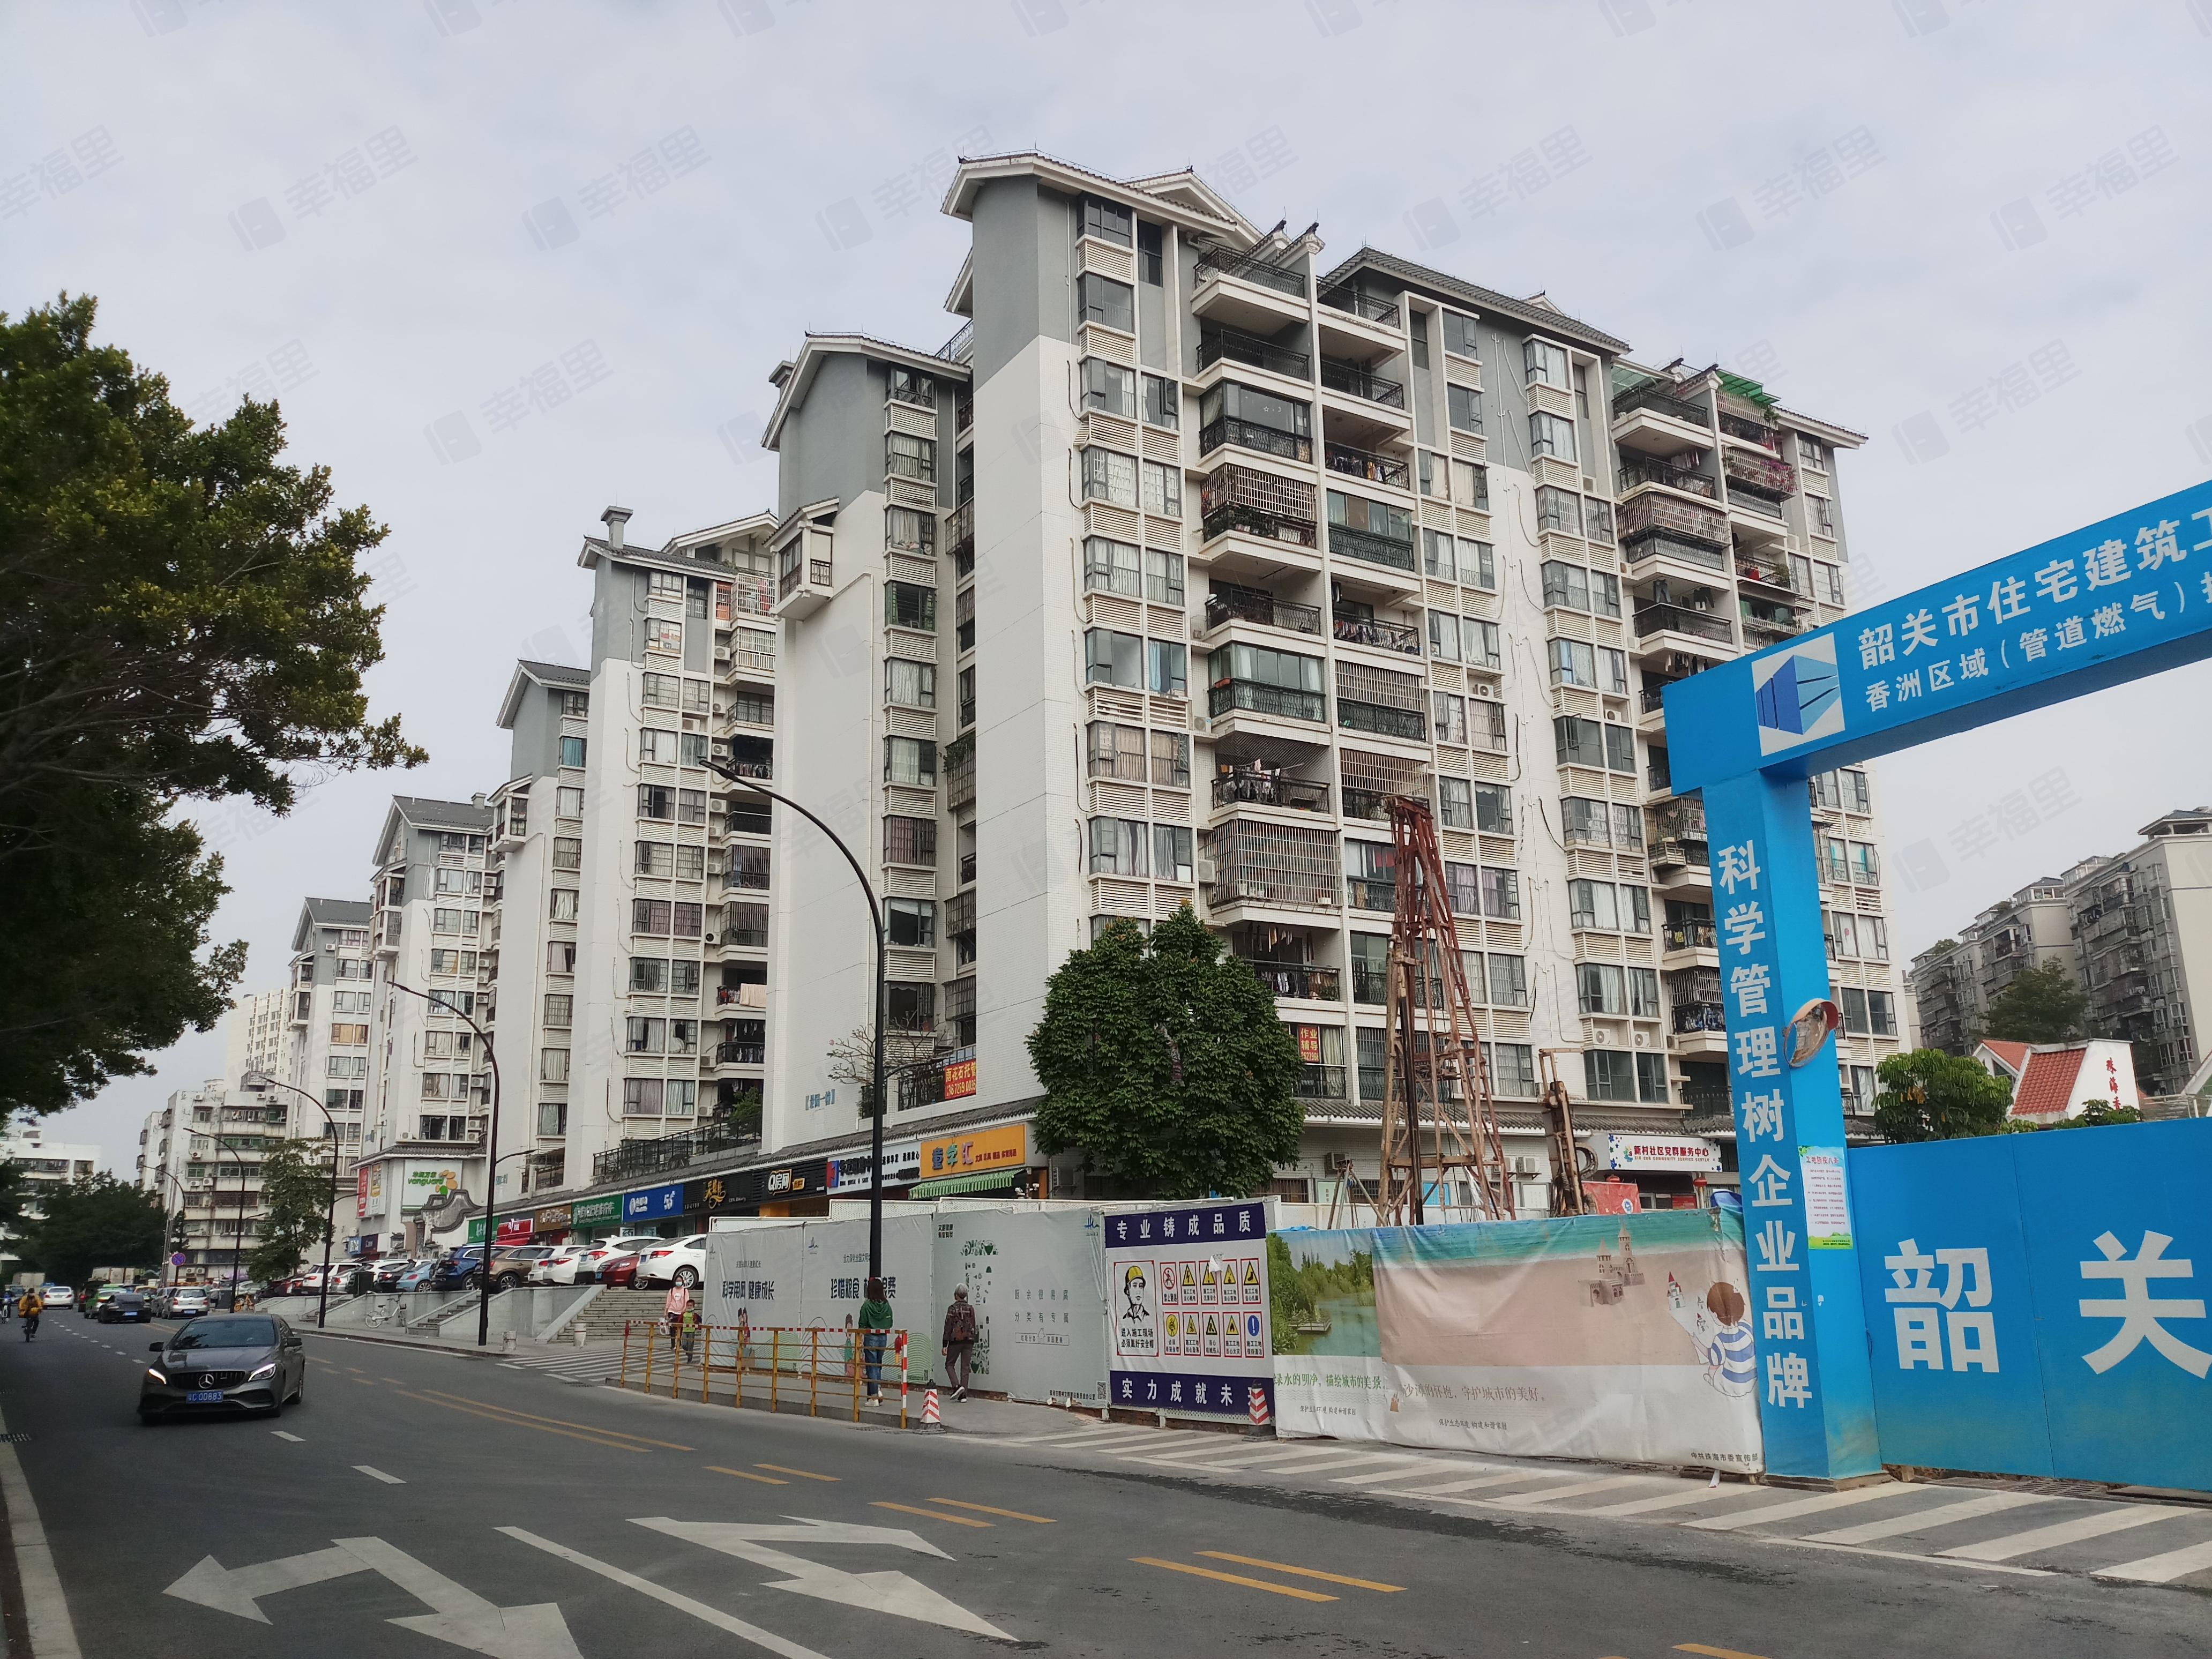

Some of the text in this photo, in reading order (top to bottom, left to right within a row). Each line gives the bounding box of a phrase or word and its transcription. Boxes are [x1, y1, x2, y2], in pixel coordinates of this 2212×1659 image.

[1301, 1028, 1318, 1038] 作业
[1301, 1040, 1318, 1051] 辅导
[946, 1062, 976, 1082] 雨花石托管
[1717, 840, 1813, 1409] 科学管理树企业品牌
[932, 1141, 974, 1171] 童学汇
[1634, 1145, 1709, 1157] 新村社区党群服务中心
[407, 1178, 445, 1186] vanguard
[768, 1171, 790, 1191] Q房网
[1117, 1210, 1251, 1241] 专业铸成品质
[722, 1280, 775, 1300] 科学用网 健康成长
[831, 1277, 860, 1299] 珍惜粮食
[1121, 1328, 1154, 1337] 进入施工现场
